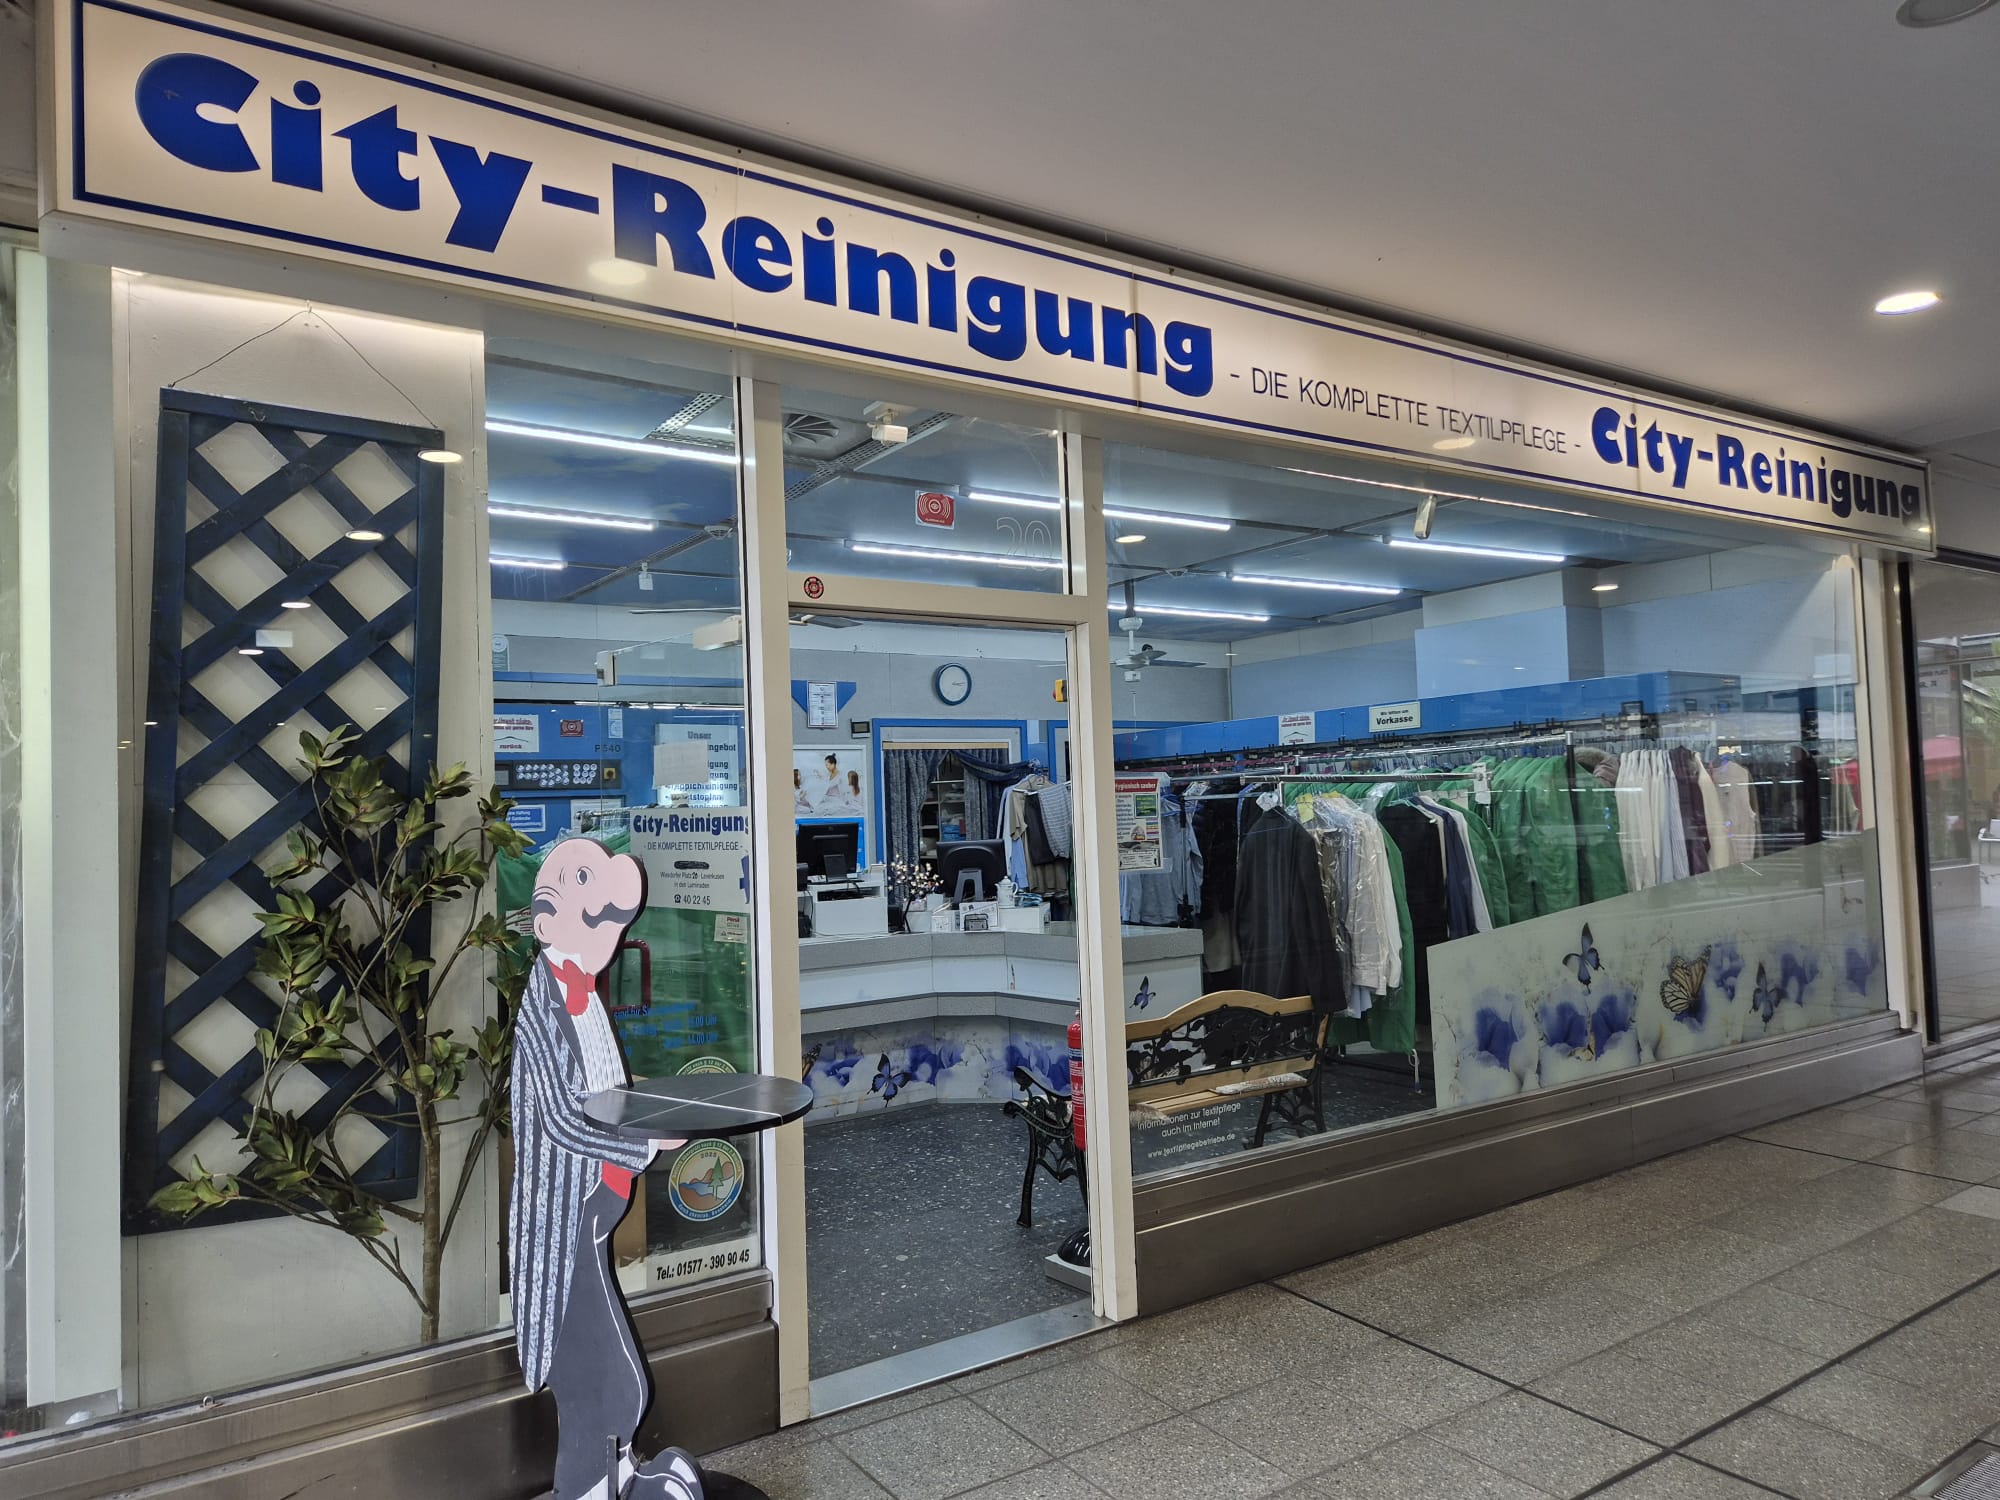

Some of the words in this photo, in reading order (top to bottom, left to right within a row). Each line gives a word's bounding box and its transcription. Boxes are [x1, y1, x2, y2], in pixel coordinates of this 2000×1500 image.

[135, 52, 1215, 398] City-Reinigung
[1252, 367, 1289, 399] DIE
[1299, 377, 1430, 427] KOMPLETTE
[1436, 406, 1568, 454] TEXTILPFLEGE
[1591, 407, 1920, 532] City-Reinigung
[1376, 715, 1414, 725] Vorkasse
[687, 731, 712, 740] Unser
[647, 841, 656, 850] DIE
[657, 841, 693, 850] KOMPLETTE
[694, 841, 739, 850] TEXTILPFLEGE
[683, 895, 692, 905] 40
[692, 895, 701, 905] 22
[702, 895, 711, 906] 45
[1137, 1113, 1189, 1130] Informationen
[1190, 1111, 1201, 1120] zur
[1202, 1102, 1241, 1117] Textilpflege
[1161, 1126, 1181, 1138] auch
[1182, 1123, 1192, 1133] im
[1193, 1117, 1220, 1130] Internet
[656, 1265, 675, 1281] Tel.:
[676, 1258, 703, 1277] 01577
[709, 1254, 725, 1270] 390
[727, 1251, 737, 1266] 90
[739, 1248, 750, 1263] 45
